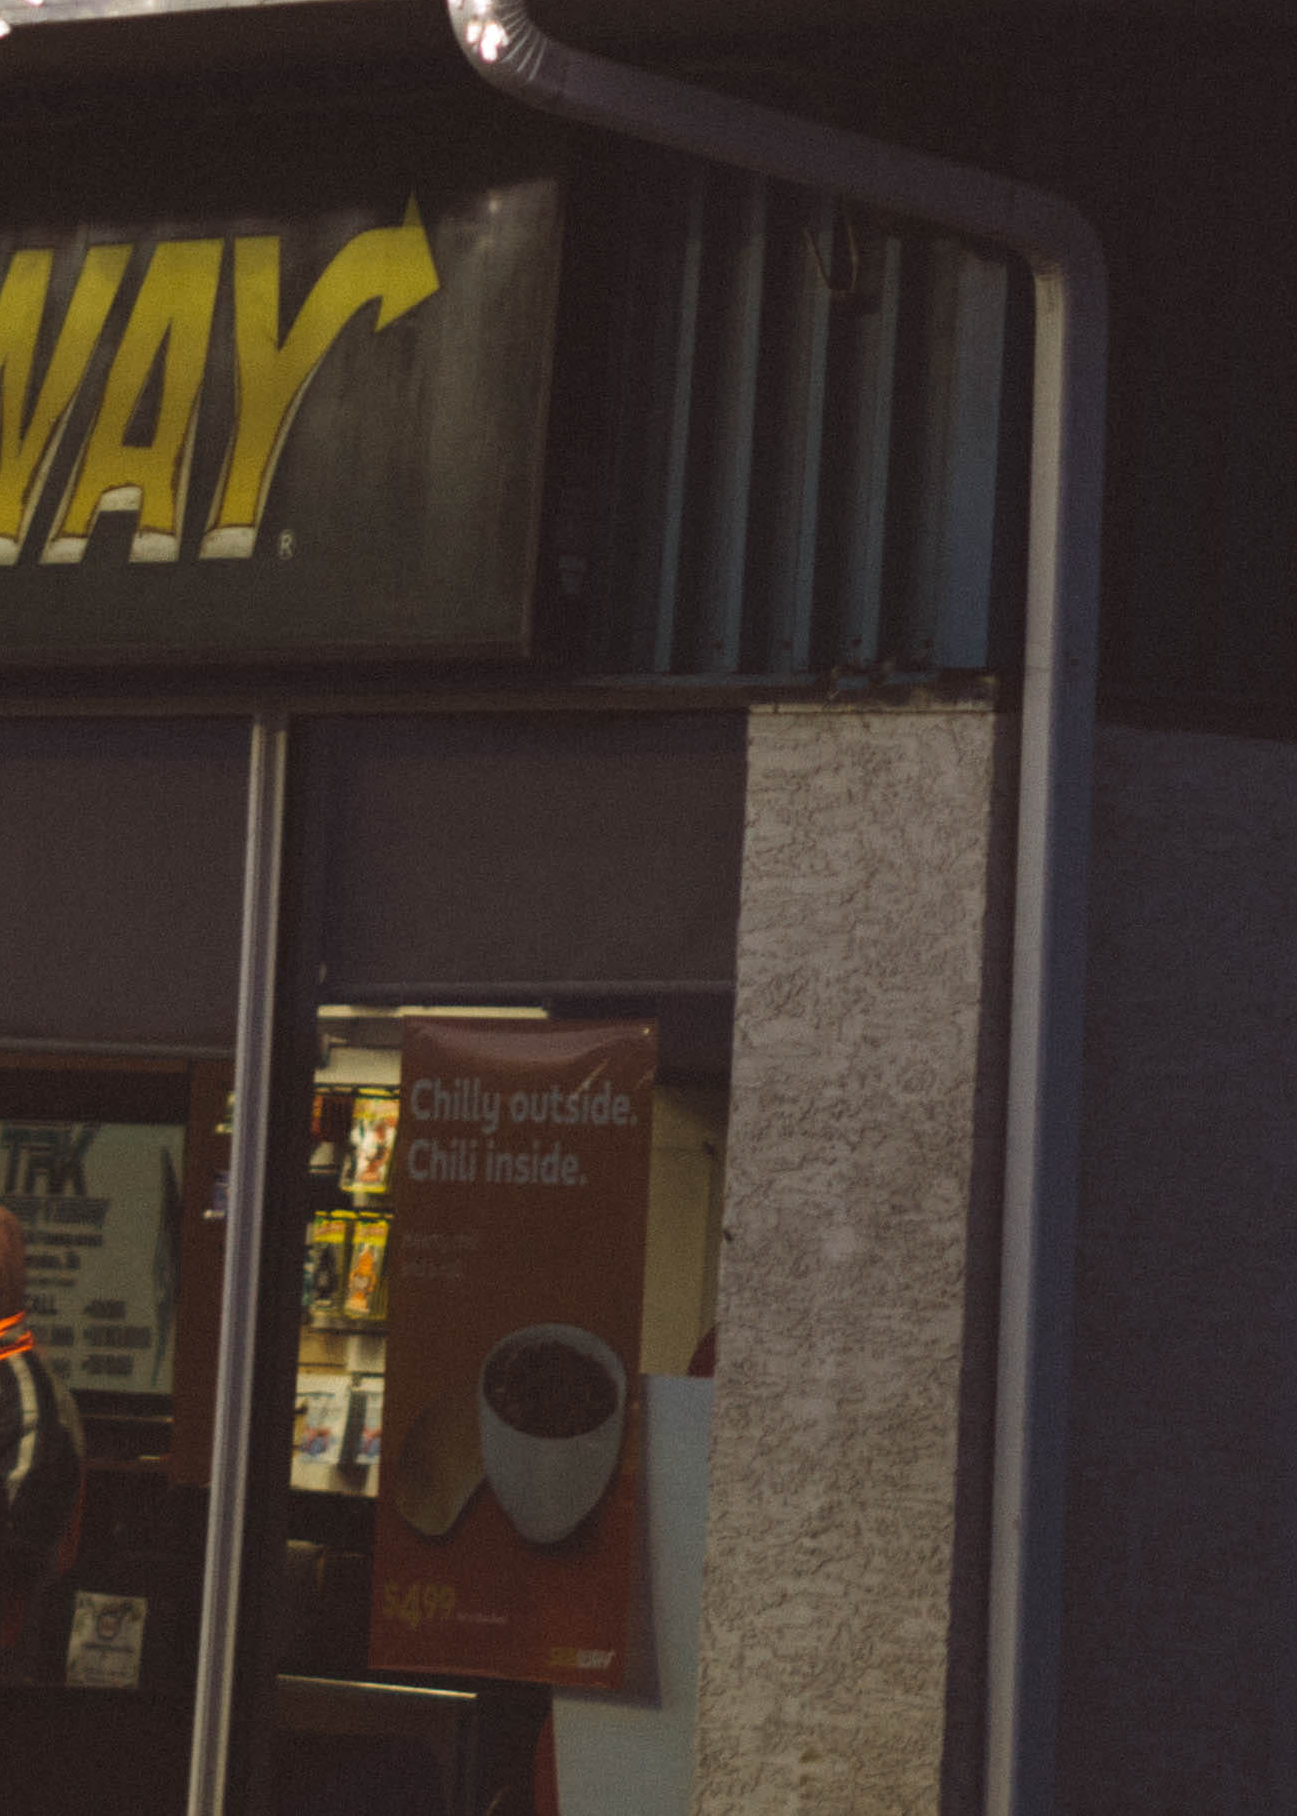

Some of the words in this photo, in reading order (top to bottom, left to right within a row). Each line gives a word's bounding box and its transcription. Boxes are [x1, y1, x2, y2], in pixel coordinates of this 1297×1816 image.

[409, 1077, 501, 1133] Chilly
[509, 1080, 639, 1127] outside.
[406, 1138, 478, 1183] Chili
[485, 1142, 588, 1186] inside.
